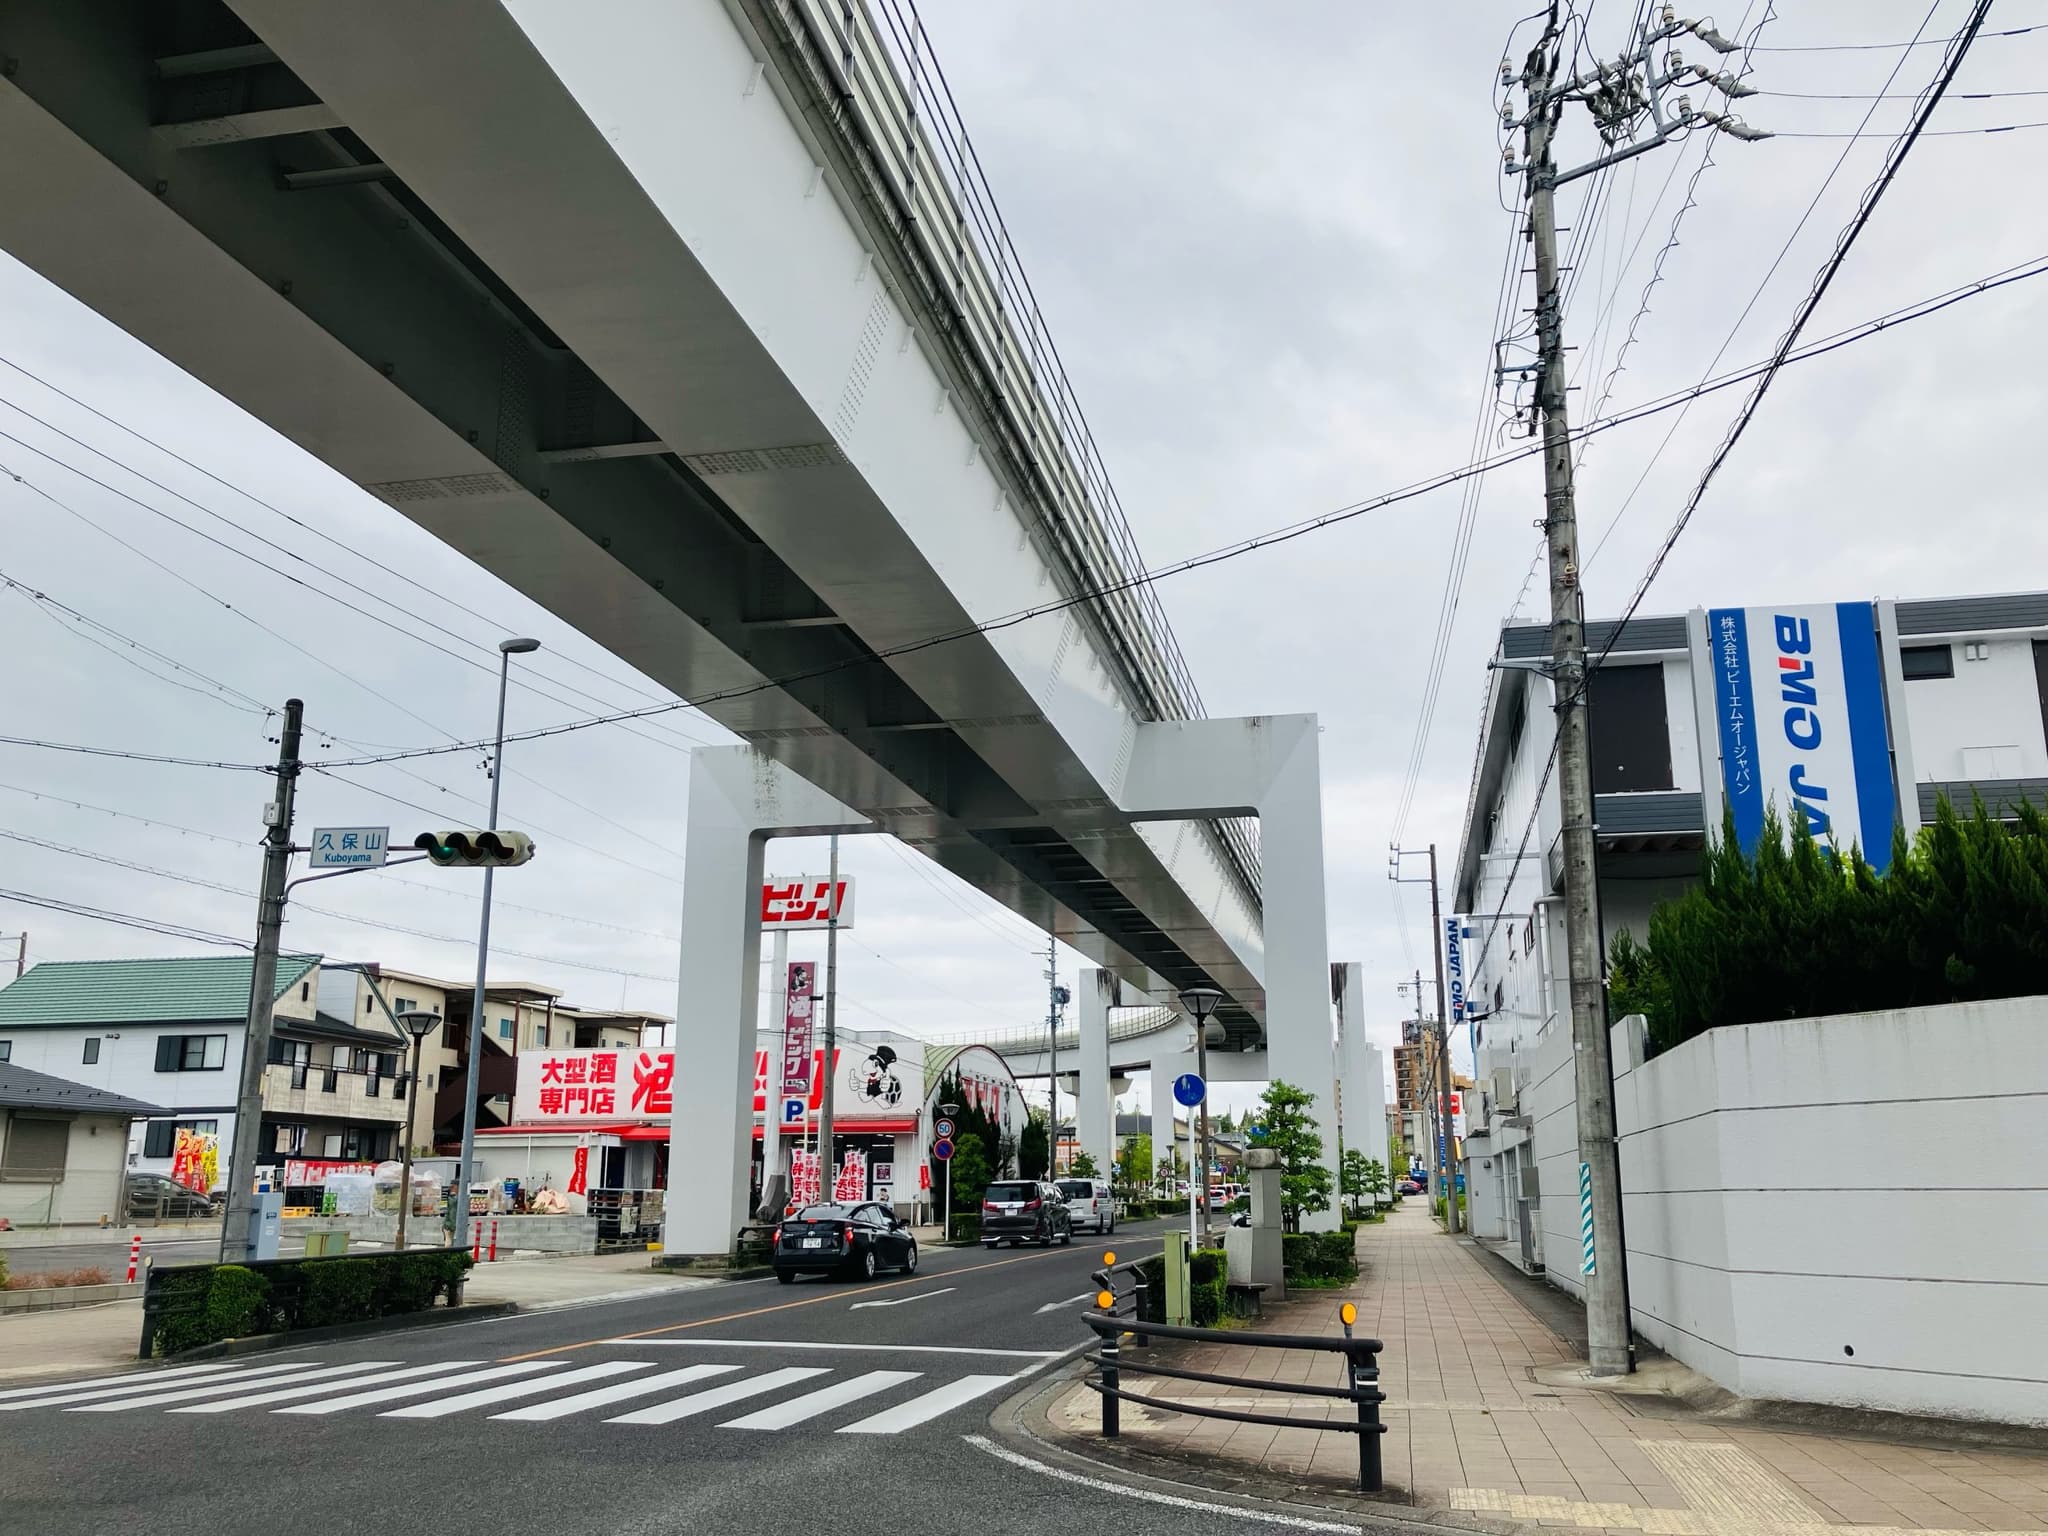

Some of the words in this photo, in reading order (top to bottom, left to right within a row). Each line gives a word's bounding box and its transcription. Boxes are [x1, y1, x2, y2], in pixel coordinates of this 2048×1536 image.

[318, 832, 382, 851] 久保山
[324, 852, 372, 864] Kuboyama
[1447, 920, 1461, 977] JAPAN
[540, 1052, 618, 1085] 大型酒
[538, 1086, 616, 1115] 専門店
[785, 1100, 805, 1122] P
[938, 1124, 951, 1134] 50
